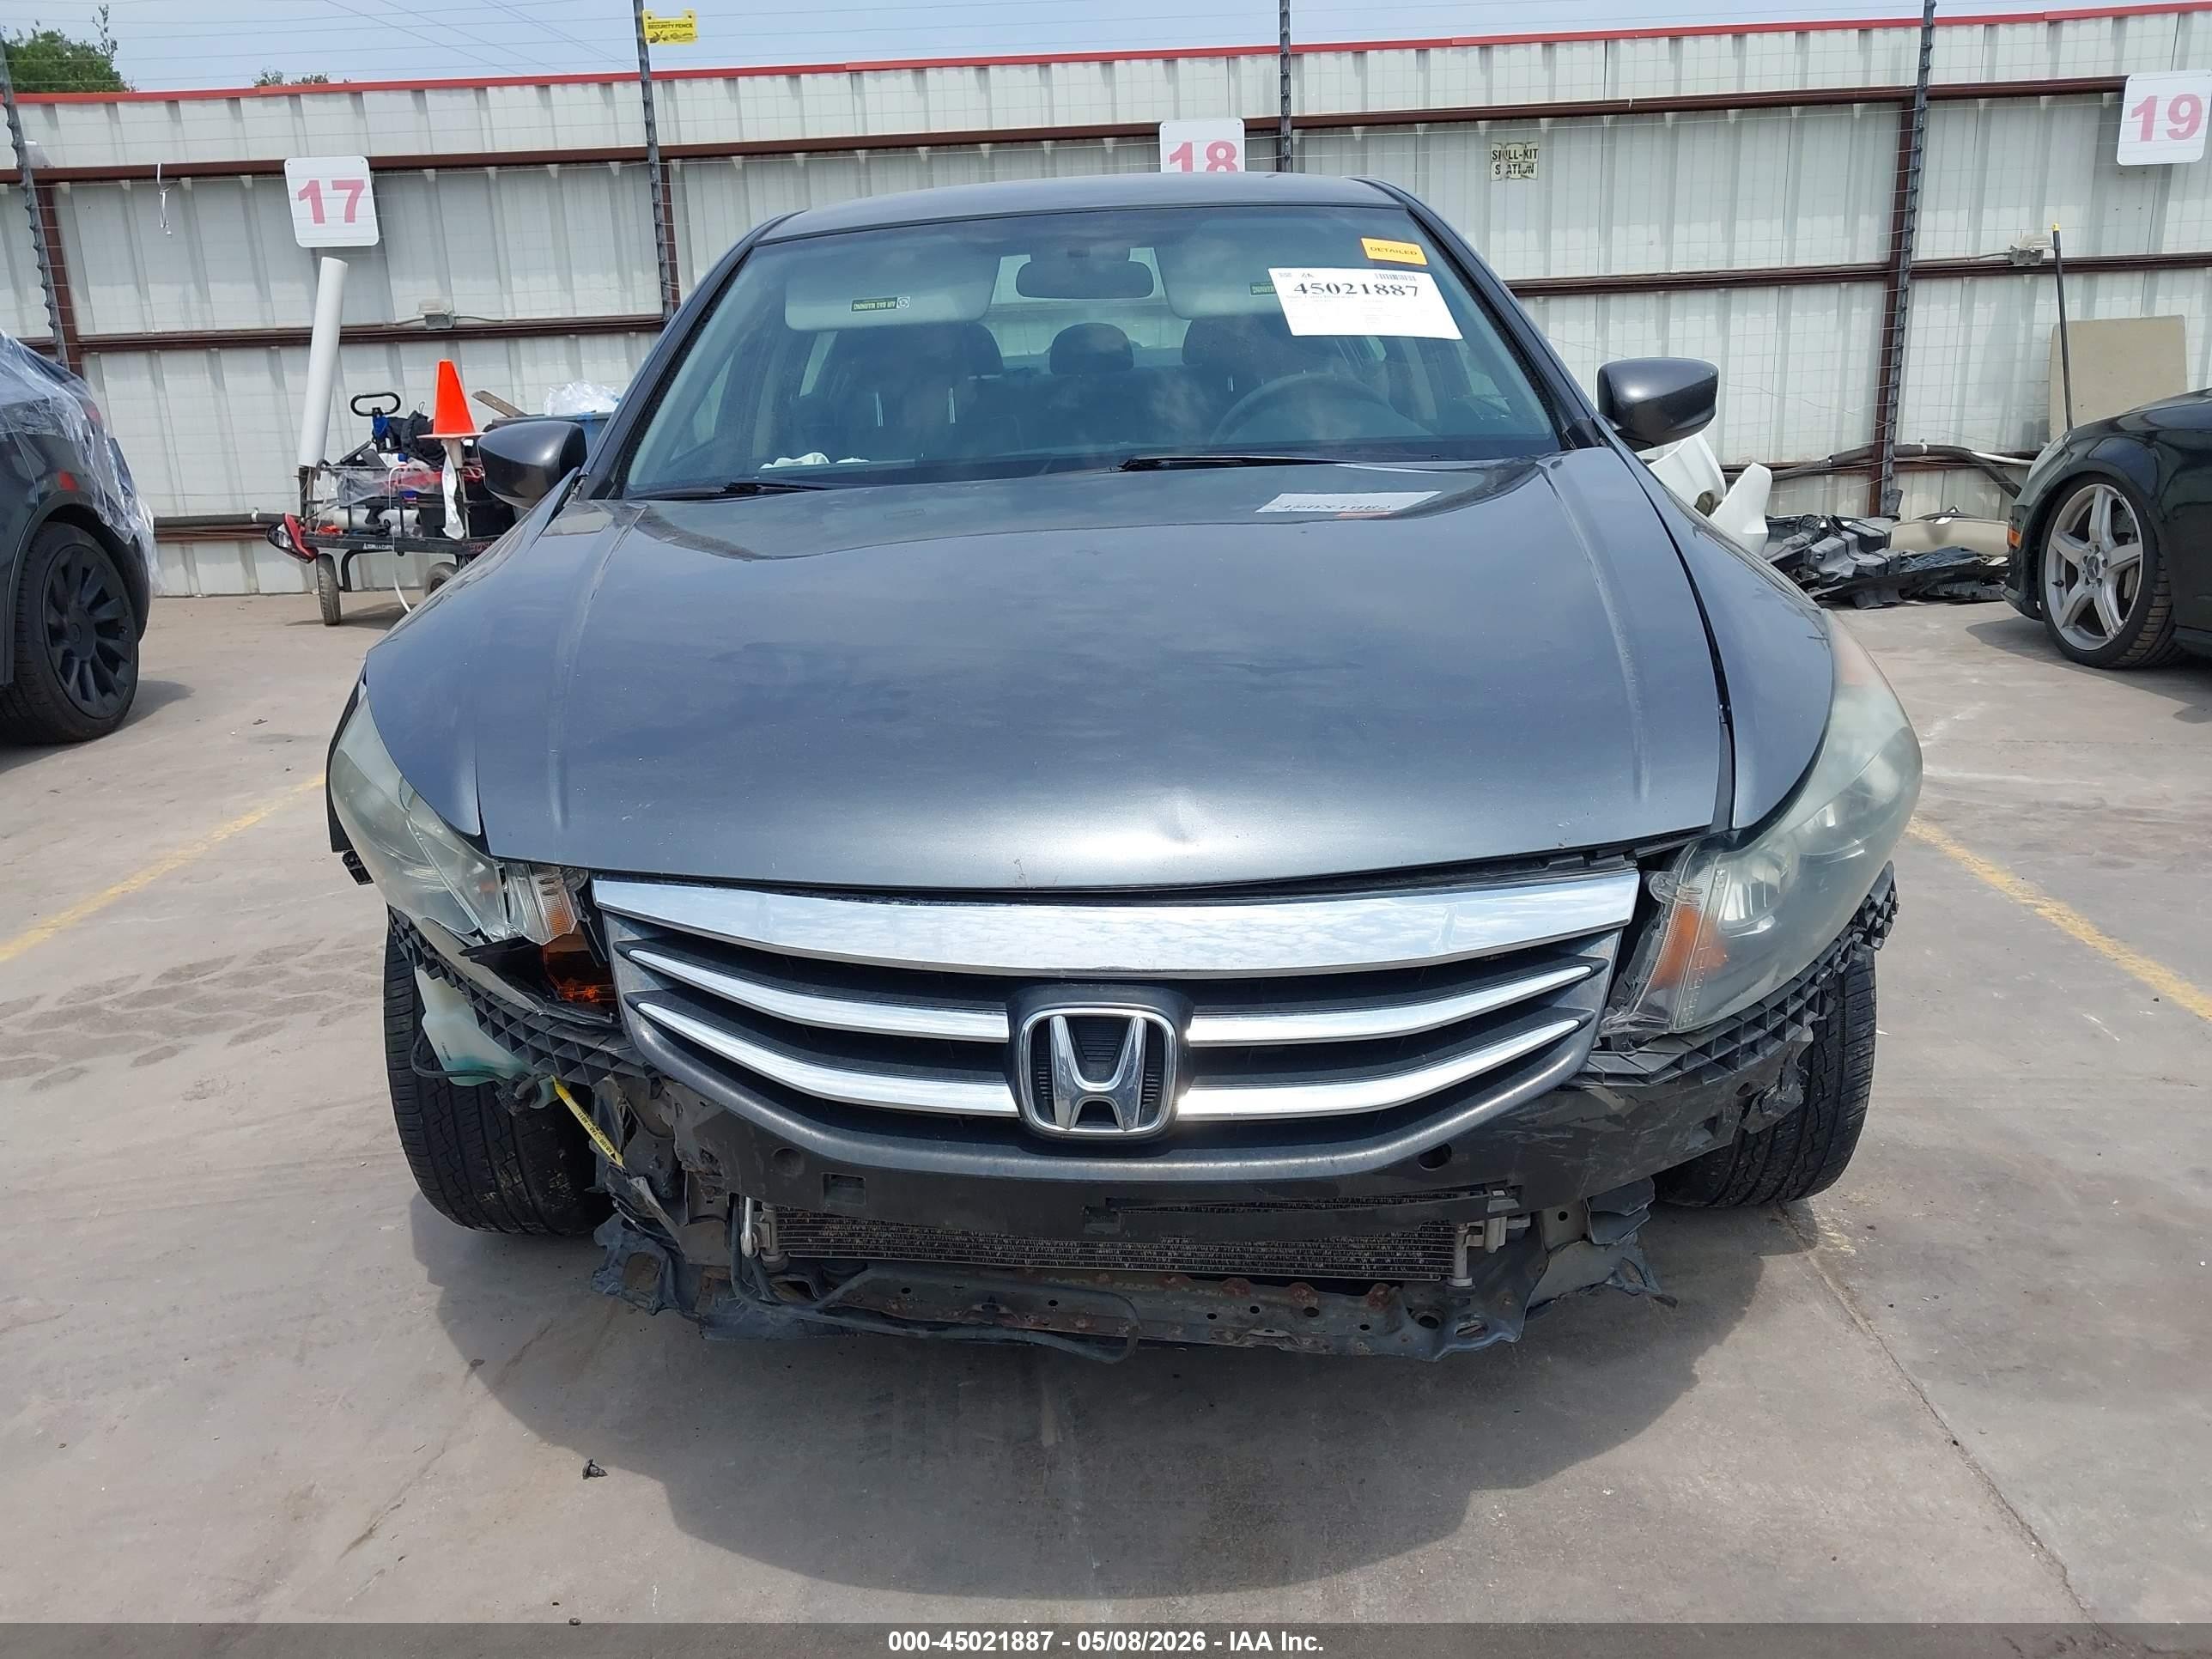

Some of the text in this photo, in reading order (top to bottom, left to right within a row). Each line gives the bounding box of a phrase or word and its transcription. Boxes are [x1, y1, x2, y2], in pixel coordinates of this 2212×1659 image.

[2130, 94, 2203, 142] 19
[1170, 142, 1237, 172] 18
[297, 179, 365, 224] 17
[1370, 246, 1418, 255] DETAILED
[1293, 282, 1419, 297] 45021887
